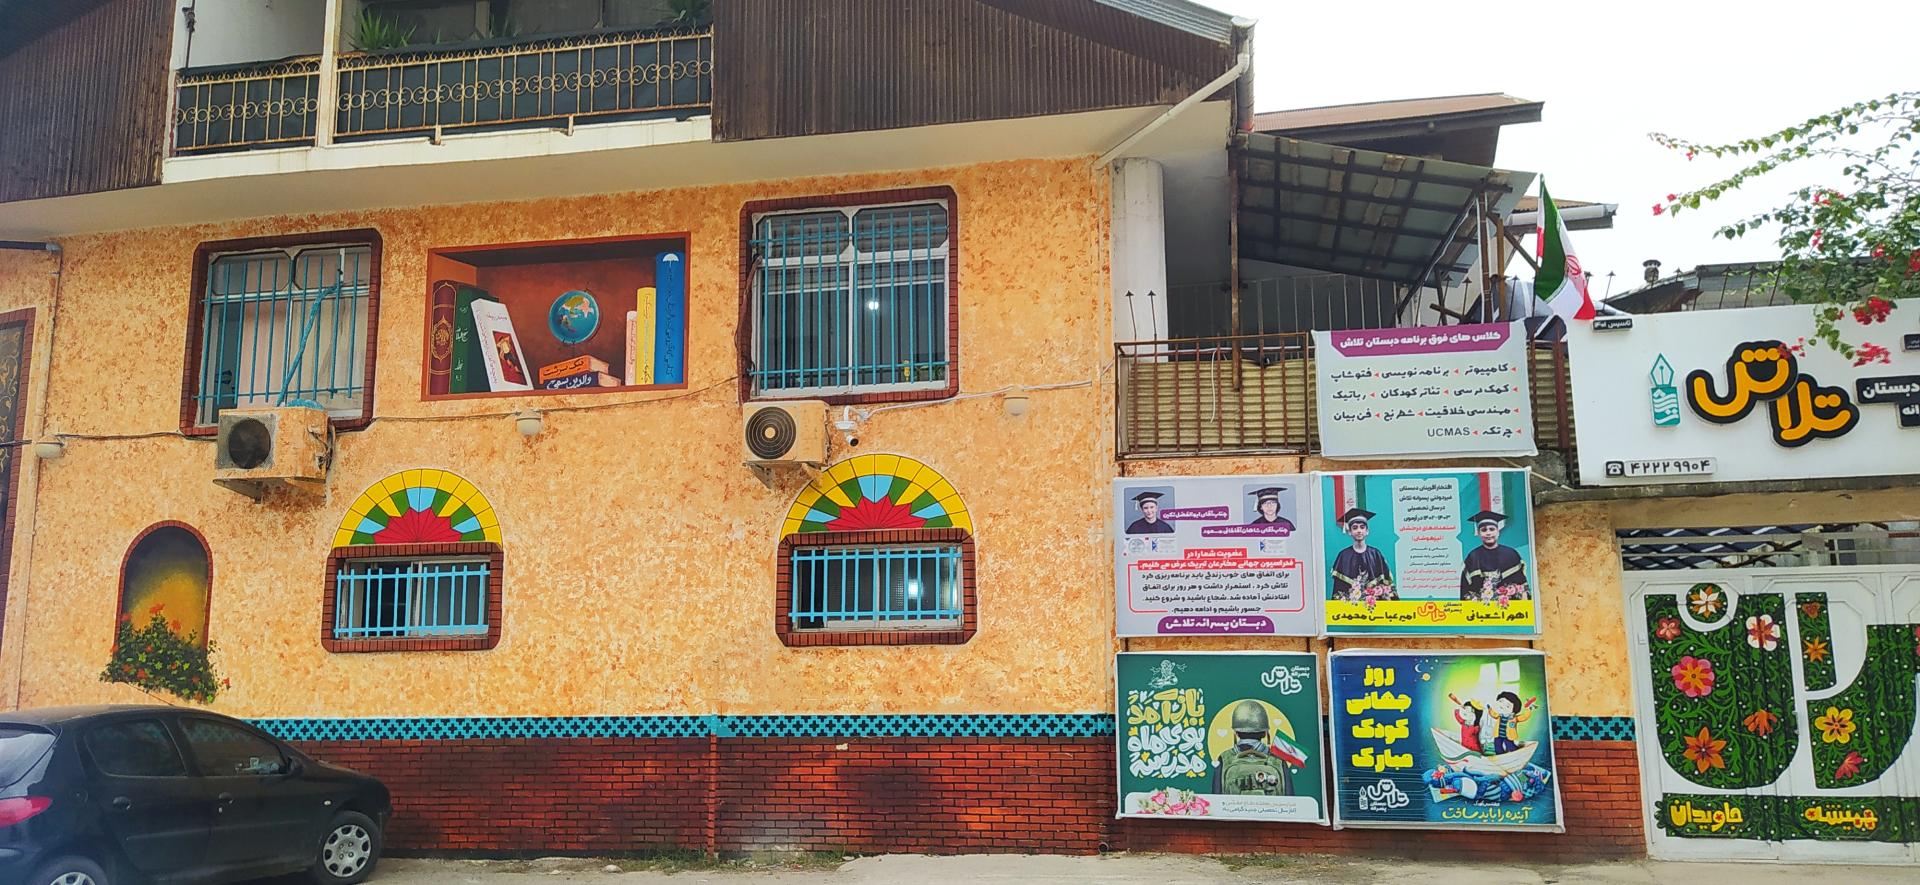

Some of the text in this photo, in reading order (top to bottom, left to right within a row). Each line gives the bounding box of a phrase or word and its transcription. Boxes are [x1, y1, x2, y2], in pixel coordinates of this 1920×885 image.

[1340, 331, 1501, 349] کلاس های فوق برنامه دبستان تلاش
[1330, 362, 1508, 383] کامپیوتر برنامه نویسی فتوشاپ
[1332, 384, 1509, 401] کمک درسی تئاتر کودکان رباتیک
[1692, 346, 1852, 442] تلاش
[1862, 382, 1920, 398] دبستان
[1333, 406, 1511, 422] مهندسی خلاقیت شطرنج فن بیان
[1902, 404, 1920, 415] انه
[1427, 426, 1513, 438] چرتکه UCMAS
[1630, 460, 1710, 474] ۴۲۲۲۹۹۰۴
[1142, 572, 1154, 580] کرد
[1191, 572, 1204, 580] باید
[1257, 571, 1275, 579] اتفاق
[1142, 583, 1161, 592] اتفاق
[1203, 582, 1223, 590] داشت
[1256, 582, 1270, 590] کرد
[1271, 582, 1289, 590] تلاش
[1161, 594, 1180, 603] شروع
[1332, 613, 1367, 621] محمدی
[1417, 601, 1447, 622] تلاش
[1466, 609, 1501, 622] شعبانی
[1165, 618, 1267, 631] دبستان پسرانه تلاش
[1261, 665, 1302, 695] تلاش
[1364, 664, 1395, 687] روز
[1346, 691, 1412, 715] جهانی
[1128, 723, 1205, 754] بوی ماه
[1352, 718, 1409, 745] کودک
[1129, 751, 1207, 778] مدرسه
[1351, 747, 1414, 773] مبارک
[1367, 779, 1409, 808] تلاش
[1442, 806, 1533, 823] آینده را باید ساخت
[1670, 799, 1878, 832] همیشه جاویدان
